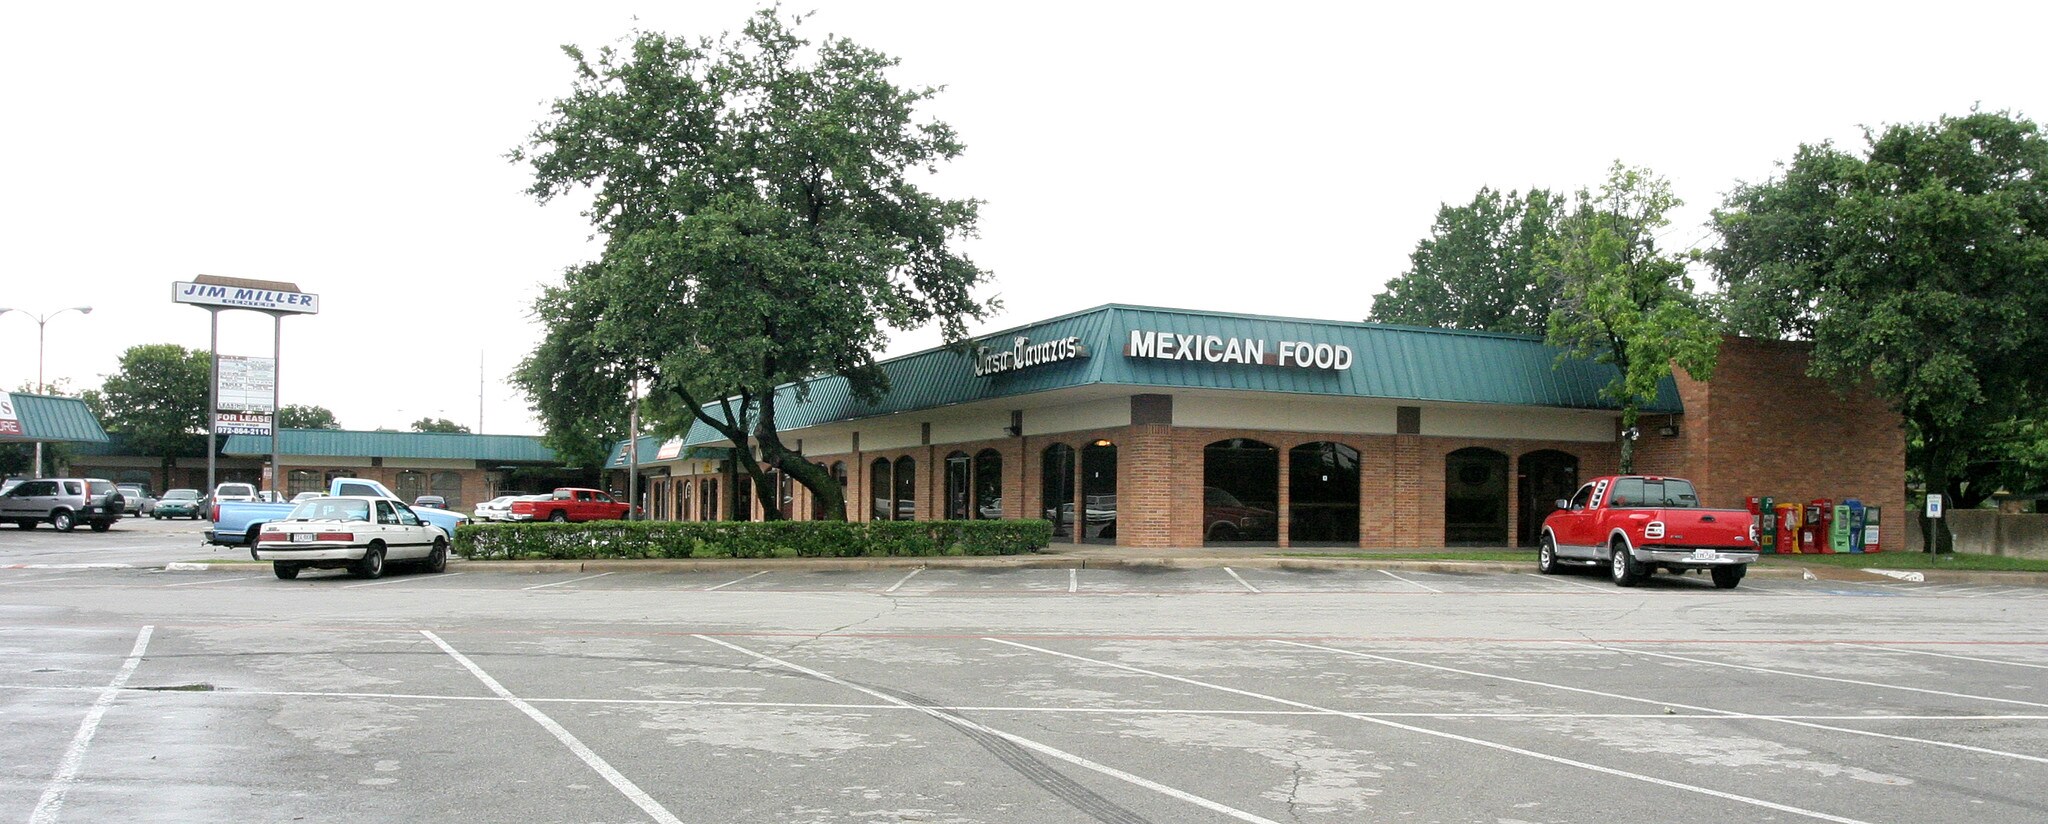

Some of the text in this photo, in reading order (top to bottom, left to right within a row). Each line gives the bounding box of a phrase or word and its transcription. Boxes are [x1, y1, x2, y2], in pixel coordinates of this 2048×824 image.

[184, 285, 312, 306] JIM MILLER
[974, 346, 1009, 377] Casa
[1130, 329, 1353, 370] MEXICAN FOOD
[217, 413, 271, 423] FOR LEASE
